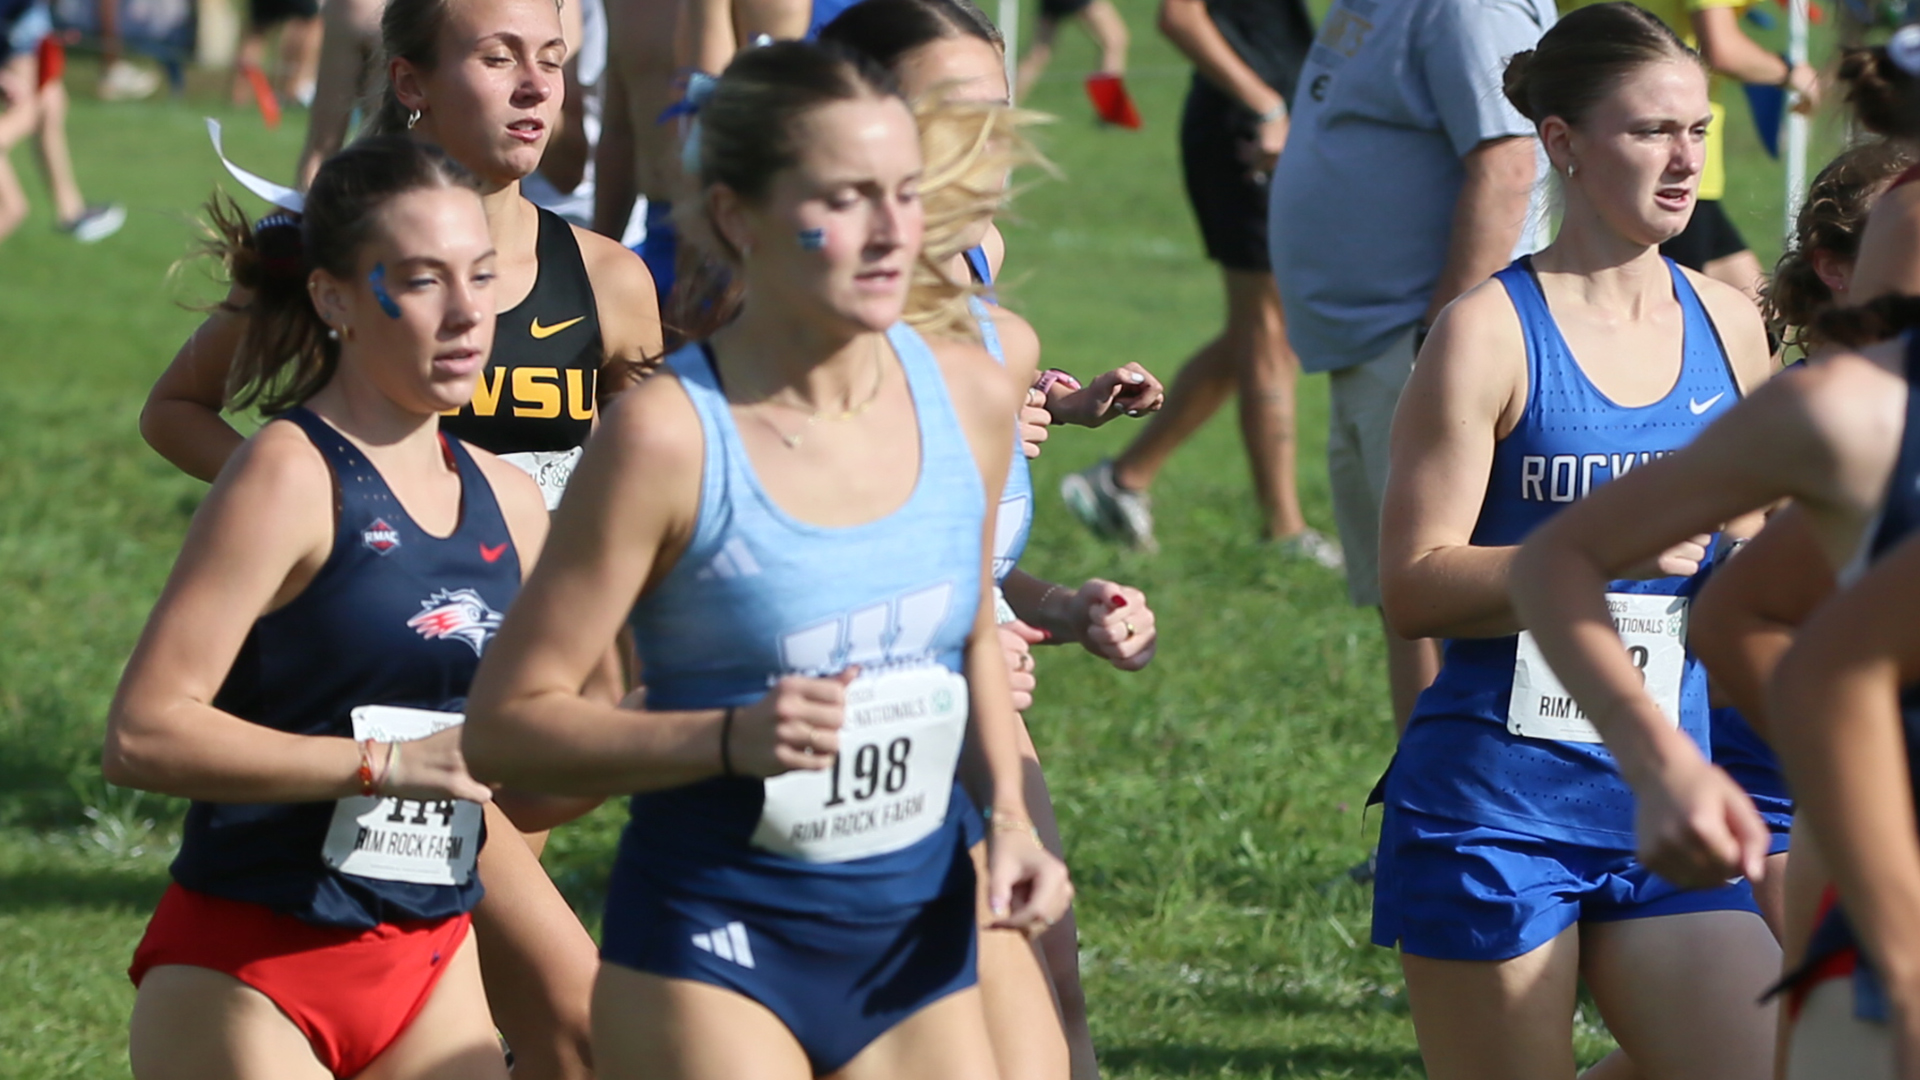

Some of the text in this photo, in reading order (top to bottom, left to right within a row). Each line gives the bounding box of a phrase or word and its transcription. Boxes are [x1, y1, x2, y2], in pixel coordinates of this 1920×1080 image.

[364, 531, 400, 545] RMAC
[1539, 696, 1570, 719] RIM
[824, 737, 911, 808] 198
[789, 820, 827, 842] RIM
[830, 807, 876, 837] ROCK
[354, 826, 386, 853] RIM
[387, 831, 428, 857] ROCK
